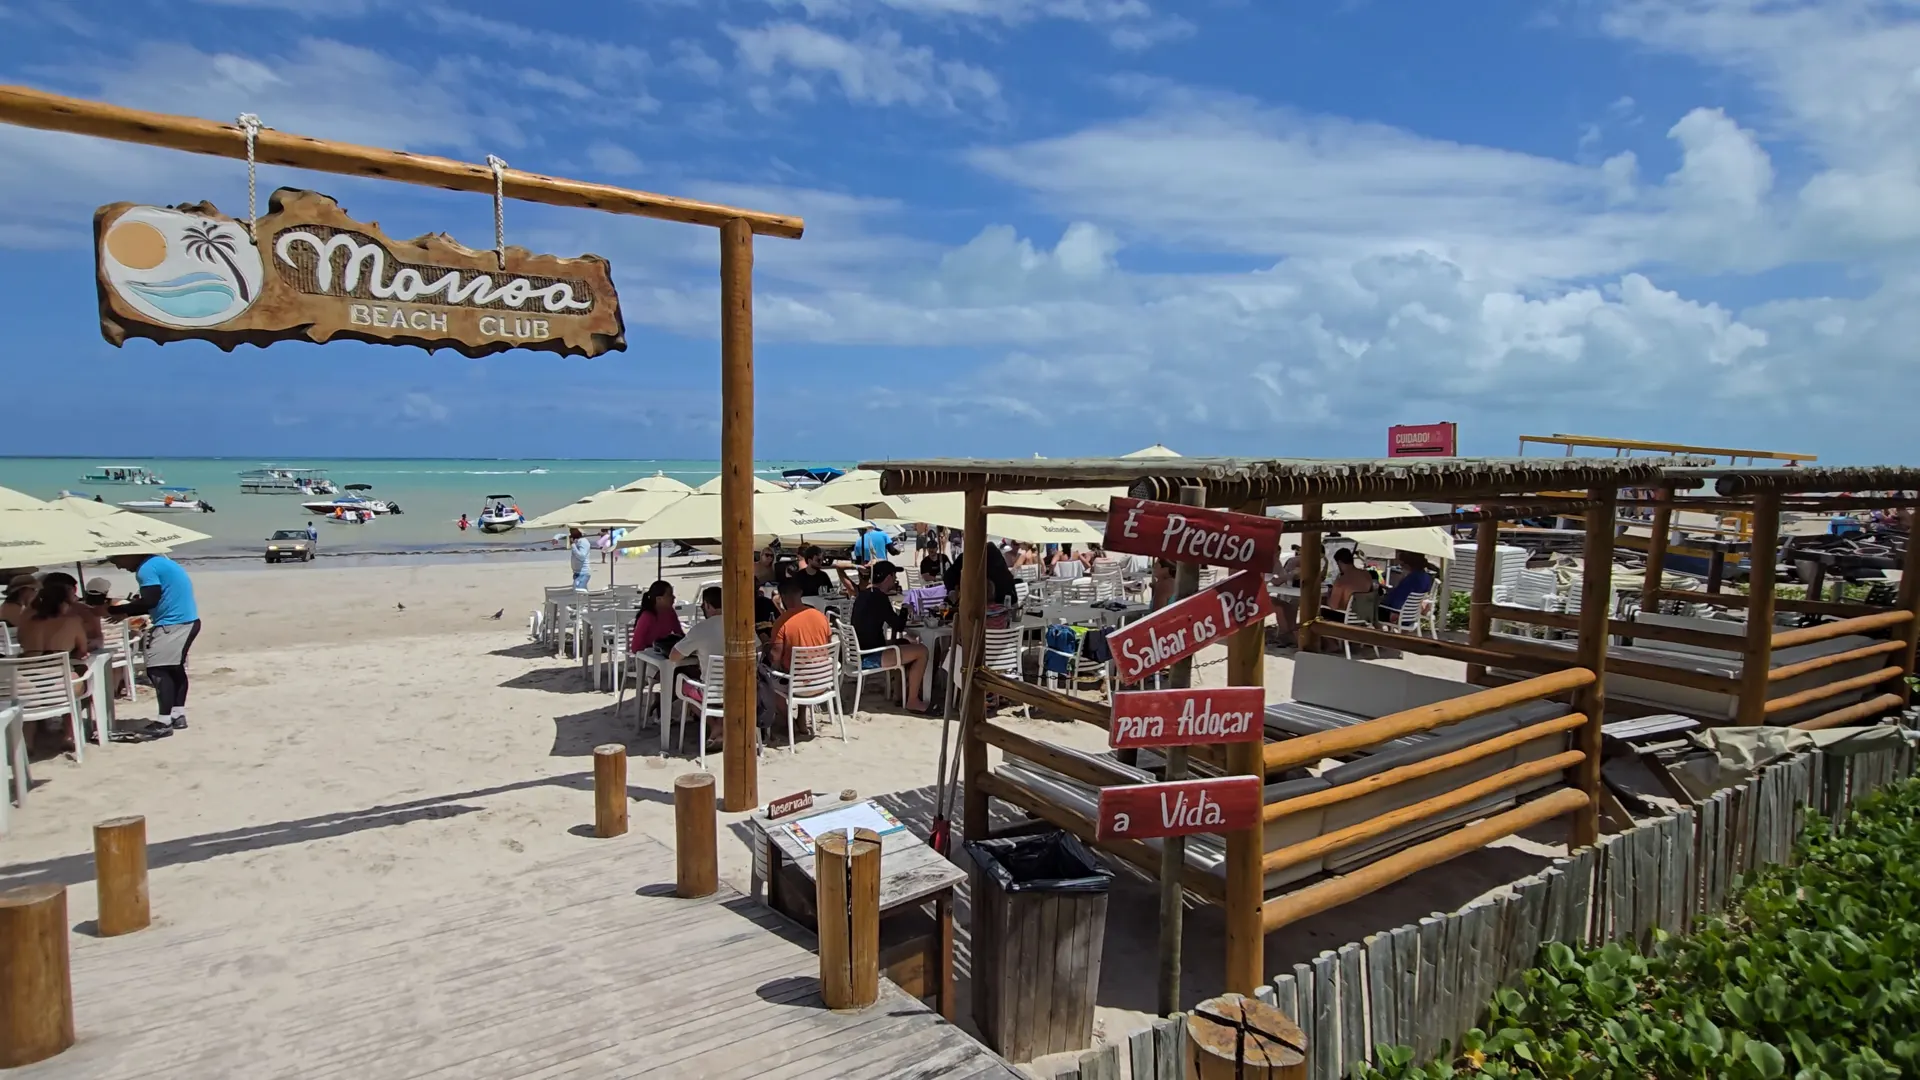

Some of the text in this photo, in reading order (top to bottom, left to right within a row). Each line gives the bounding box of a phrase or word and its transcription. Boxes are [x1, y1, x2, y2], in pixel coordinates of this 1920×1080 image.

[351, 304, 550, 339] BEACH CLUB
[1395, 432, 1430, 444] CUIDADO!
[1123, 500, 1256, 562] É Preciso
[1193, 615, 1217, 643] os
[1217, 590, 1260, 629] Pés
[1115, 698, 1253, 744] para Adoçar
[770, 793, 814, 817] Reservado
[1113, 789, 1226, 832] a Vida.
